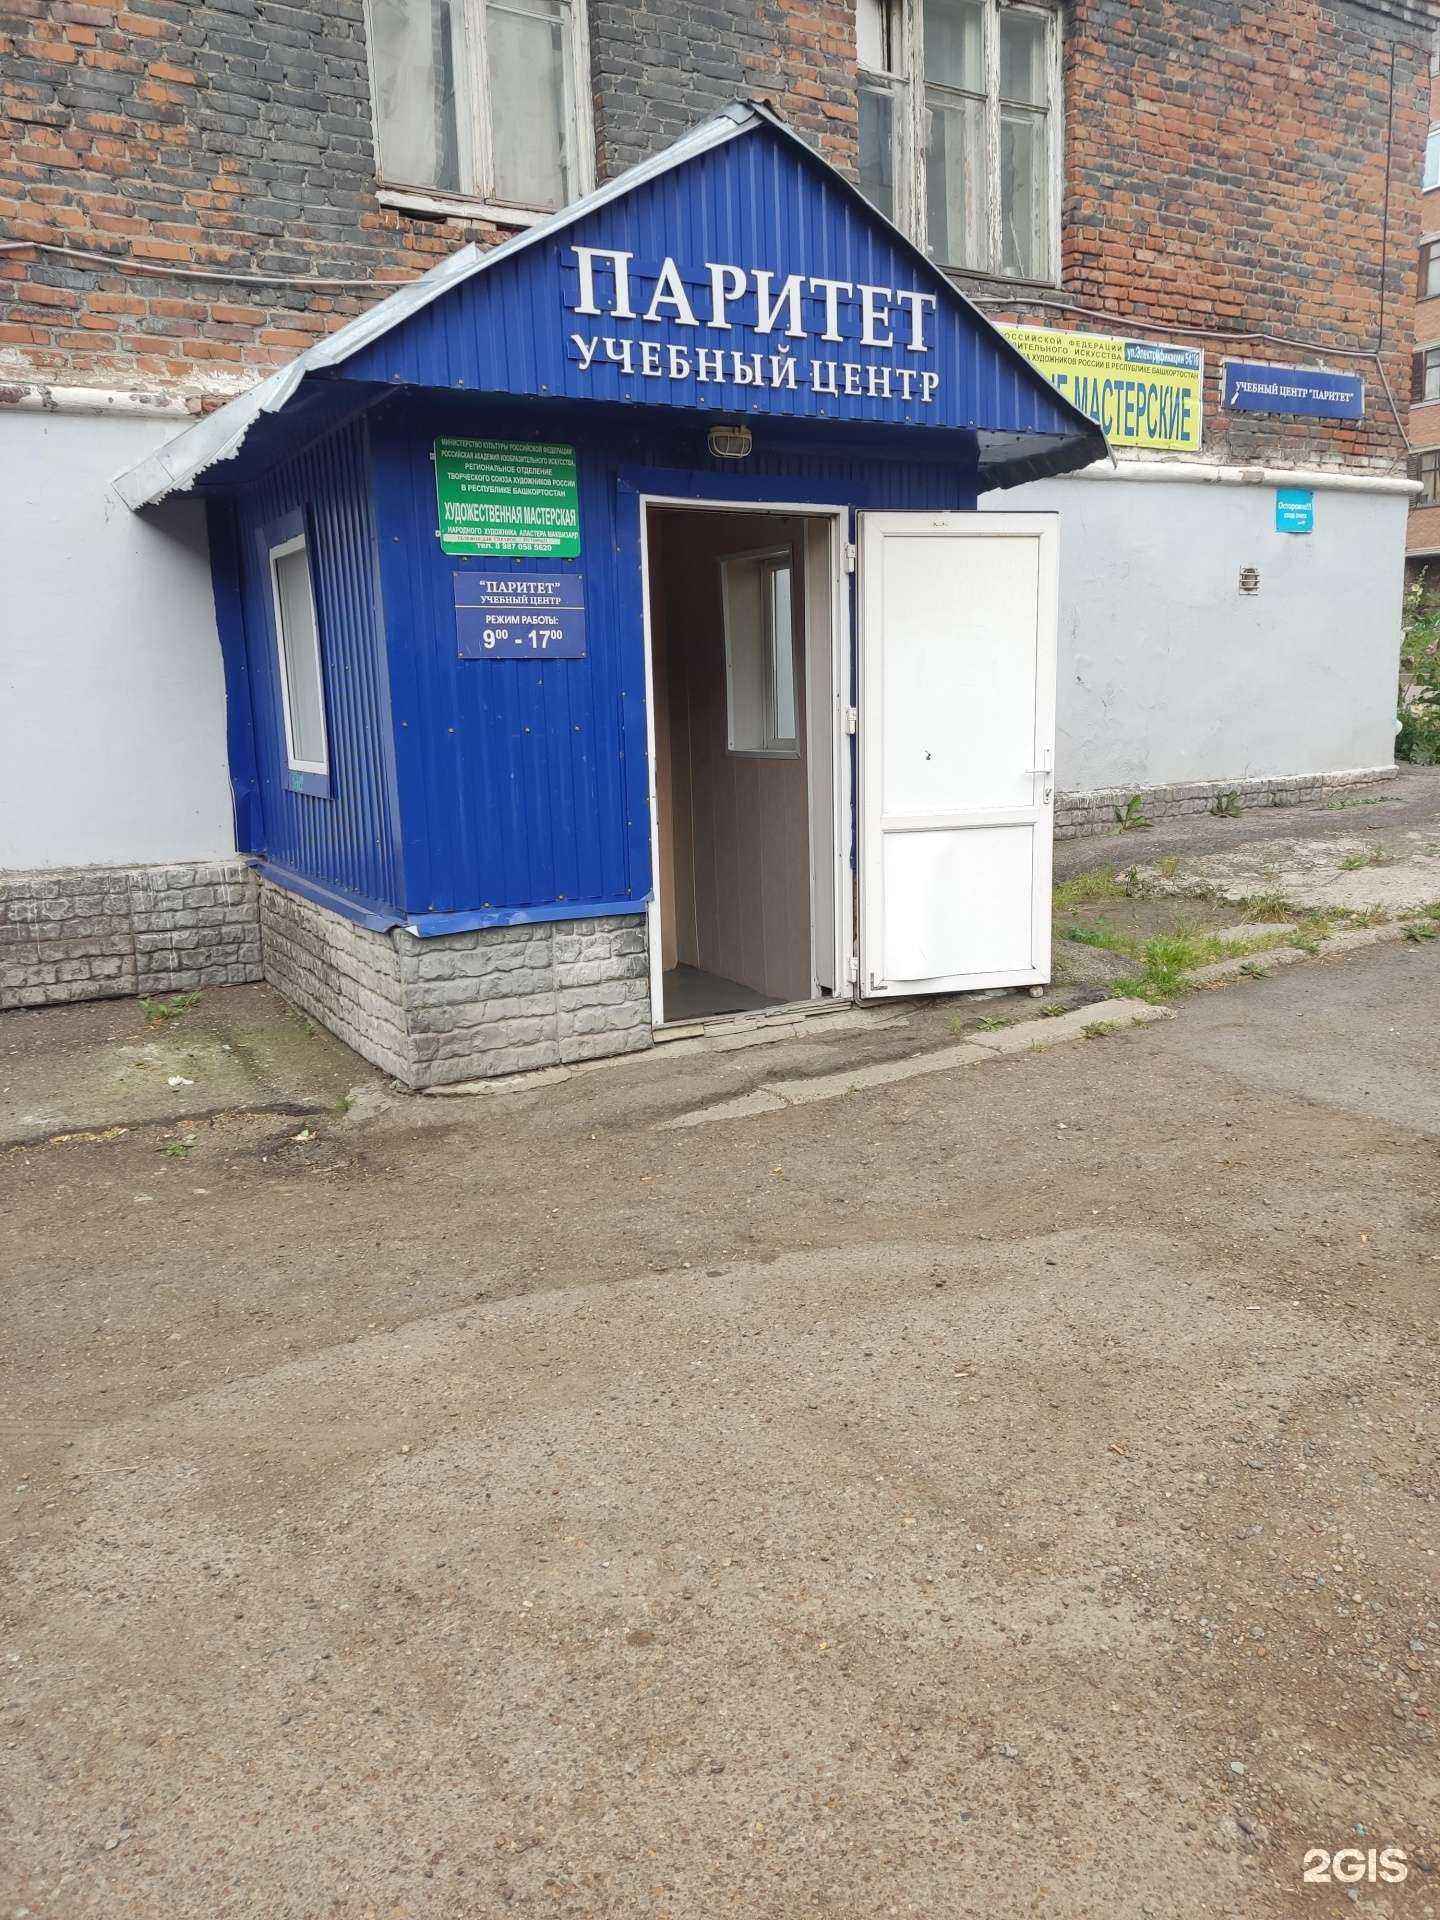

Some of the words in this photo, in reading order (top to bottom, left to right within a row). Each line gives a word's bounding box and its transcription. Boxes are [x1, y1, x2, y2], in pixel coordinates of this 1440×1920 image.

[571, 245, 937, 352] ПАРИТЕТ
[1003, 332, 1062, 345] ОССИЙСКОЙ
[1068, 340, 1122, 351] ФЕДЕРАЦИИ
[1074, 349, 1121, 360] ИСКУССТВА
[570, 333, 797, 390] УЧЕБНЫЙ
[810, 359, 940, 402] ЦЕНТР
[1031, 354, 1078, 365] ХУДОЖНИКОВ
[1078, 358, 1105, 368] РОССИИ
[1111, 363, 1151, 374] РЕСПУБЛИКЕ
[1152, 368, 1199, 380] БАШКОРТОСТАН
[1235, 381, 1278, 395] УЧЕБНЫЙ
[1279, 385, 1308, 398] ЦЕНТР
[1074, 375, 1191, 441] МАСТЕРСКИЕ
[464, 463, 515, 473] РЕГИОНАЛЬНОЕ
[516, 466, 552, 476] ОТДЕЛЕНИЕ
[447, 472, 490, 483] ТВОРЧЕСКОГО
[491, 474, 512, 484] СОЮЗА
[512, 476, 551, 487] ХУДОЖНИКОВ
[552, 478, 576, 488] РОССИИ
[467, 484, 511, 494] РЕСПУБЛИКЕ
[512, 486, 566, 497] БАШКОРТОСТАН
[444, 502, 522, 523] ХУДОЖЕСТВЕННАЯ
[523, 506, 577, 526] МАСТЕРСКАЯ
[447, 526, 482, 534] НАРОДНОГО
[483, 528, 517, 537] ХУДОЖНИКА
[480, 594, 530, 604] УЧЕБНЫЙ
[530, 596, 561, 606] ЦЕНТР
[485, 615, 520, 625] РЕЖИМ
[521, 615, 559, 625] РАБОТЫ:
